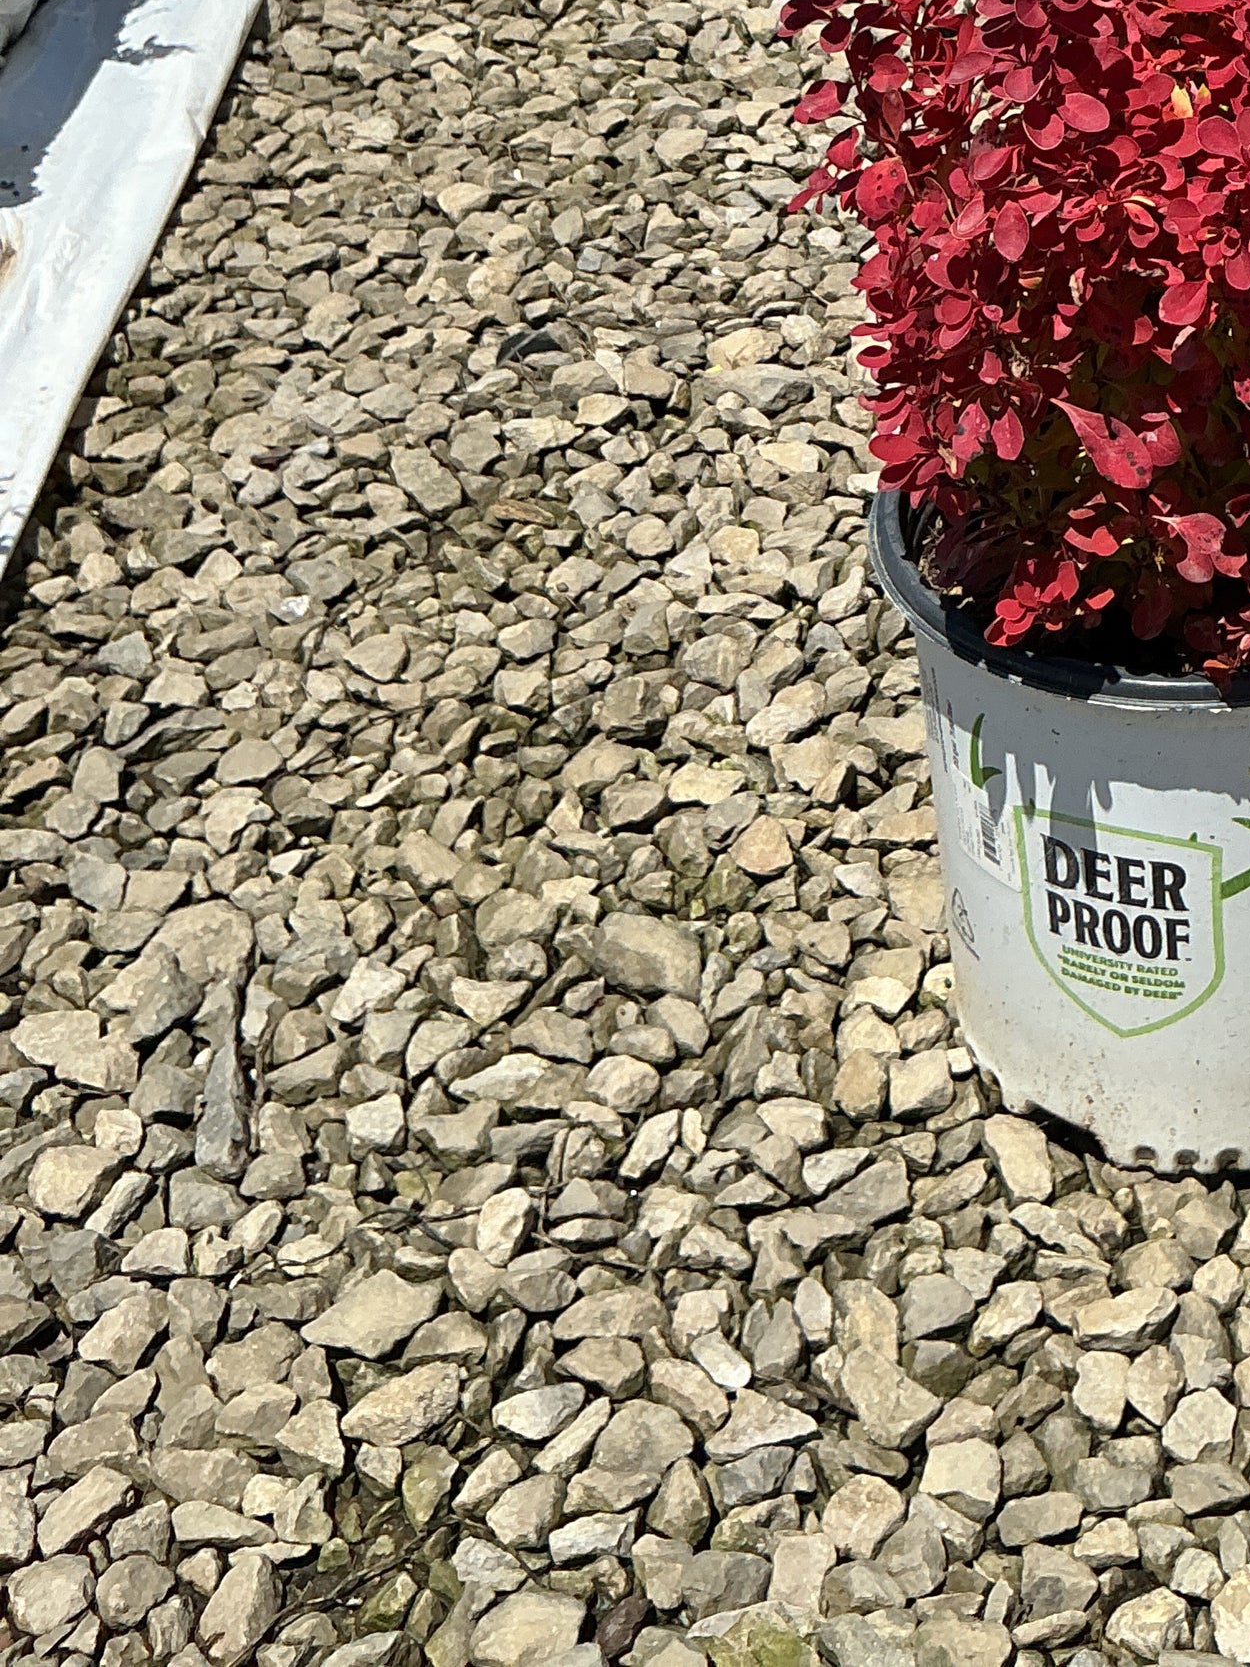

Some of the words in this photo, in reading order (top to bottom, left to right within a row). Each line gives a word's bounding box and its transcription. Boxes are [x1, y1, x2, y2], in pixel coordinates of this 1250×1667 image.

[1040, 833, 1190, 912] DEER
[1045, 888, 1191, 961] PROOF
[1062, 944, 1133, 971] UNIVERSITY
[1136, 964, 1178, 977] RATED
[1109, 970, 1130, 983] OR
[1131, 974, 1186, 989] SELDOM
